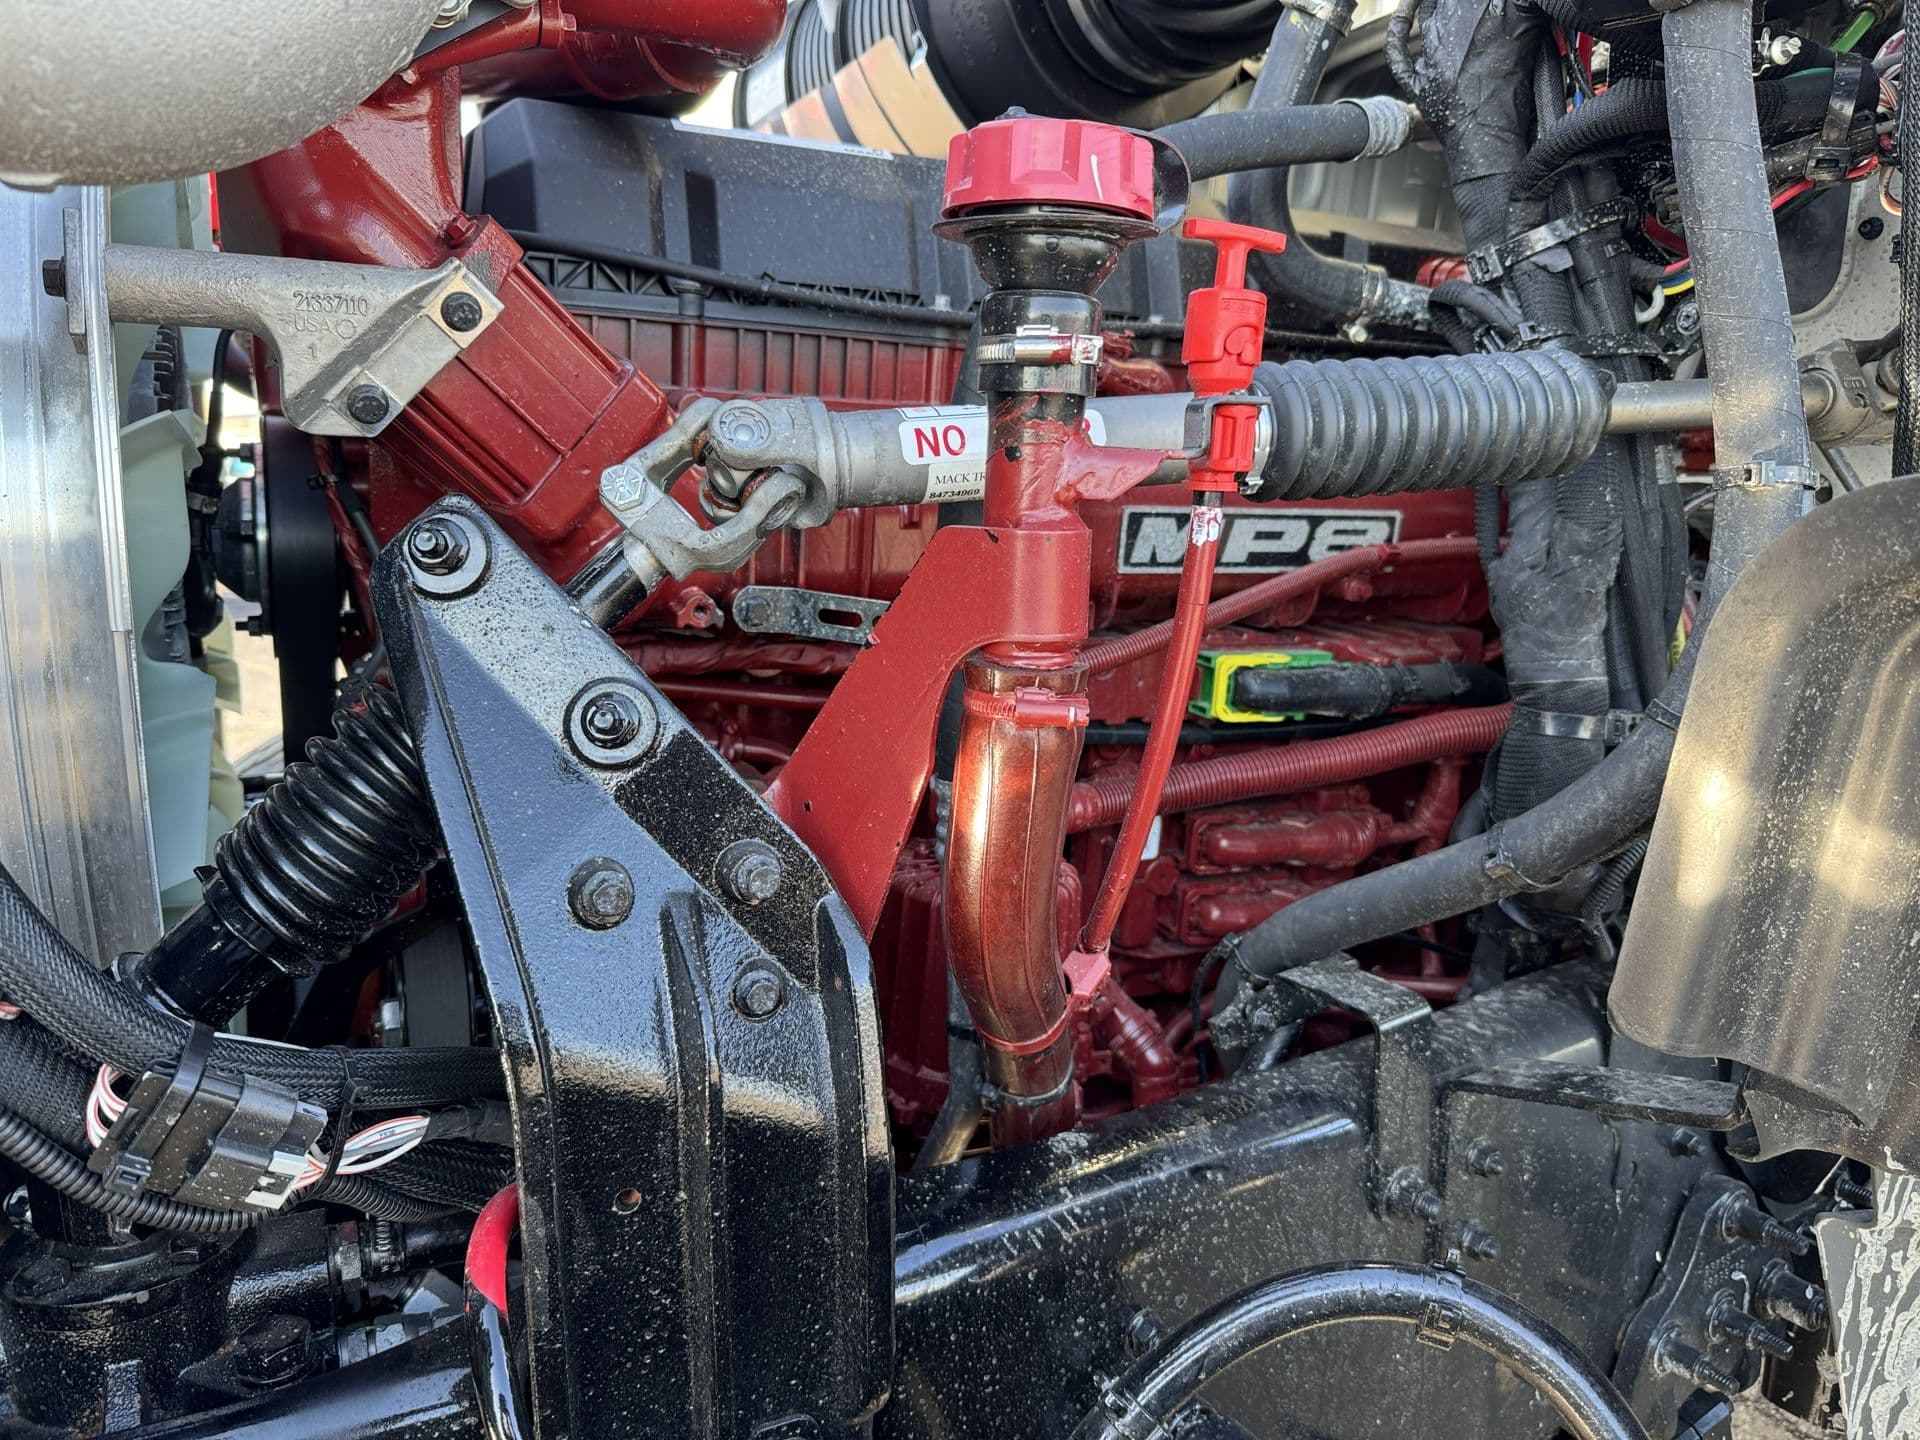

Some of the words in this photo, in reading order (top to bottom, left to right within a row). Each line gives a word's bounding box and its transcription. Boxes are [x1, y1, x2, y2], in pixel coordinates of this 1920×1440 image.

[293, 292, 367, 317] 21337110
[914, 425, 966, 458] NO
[935, 472, 970, 485] MACK
[929, 488, 980, 499] 84734969
[1129, 517, 1390, 564] MP8
